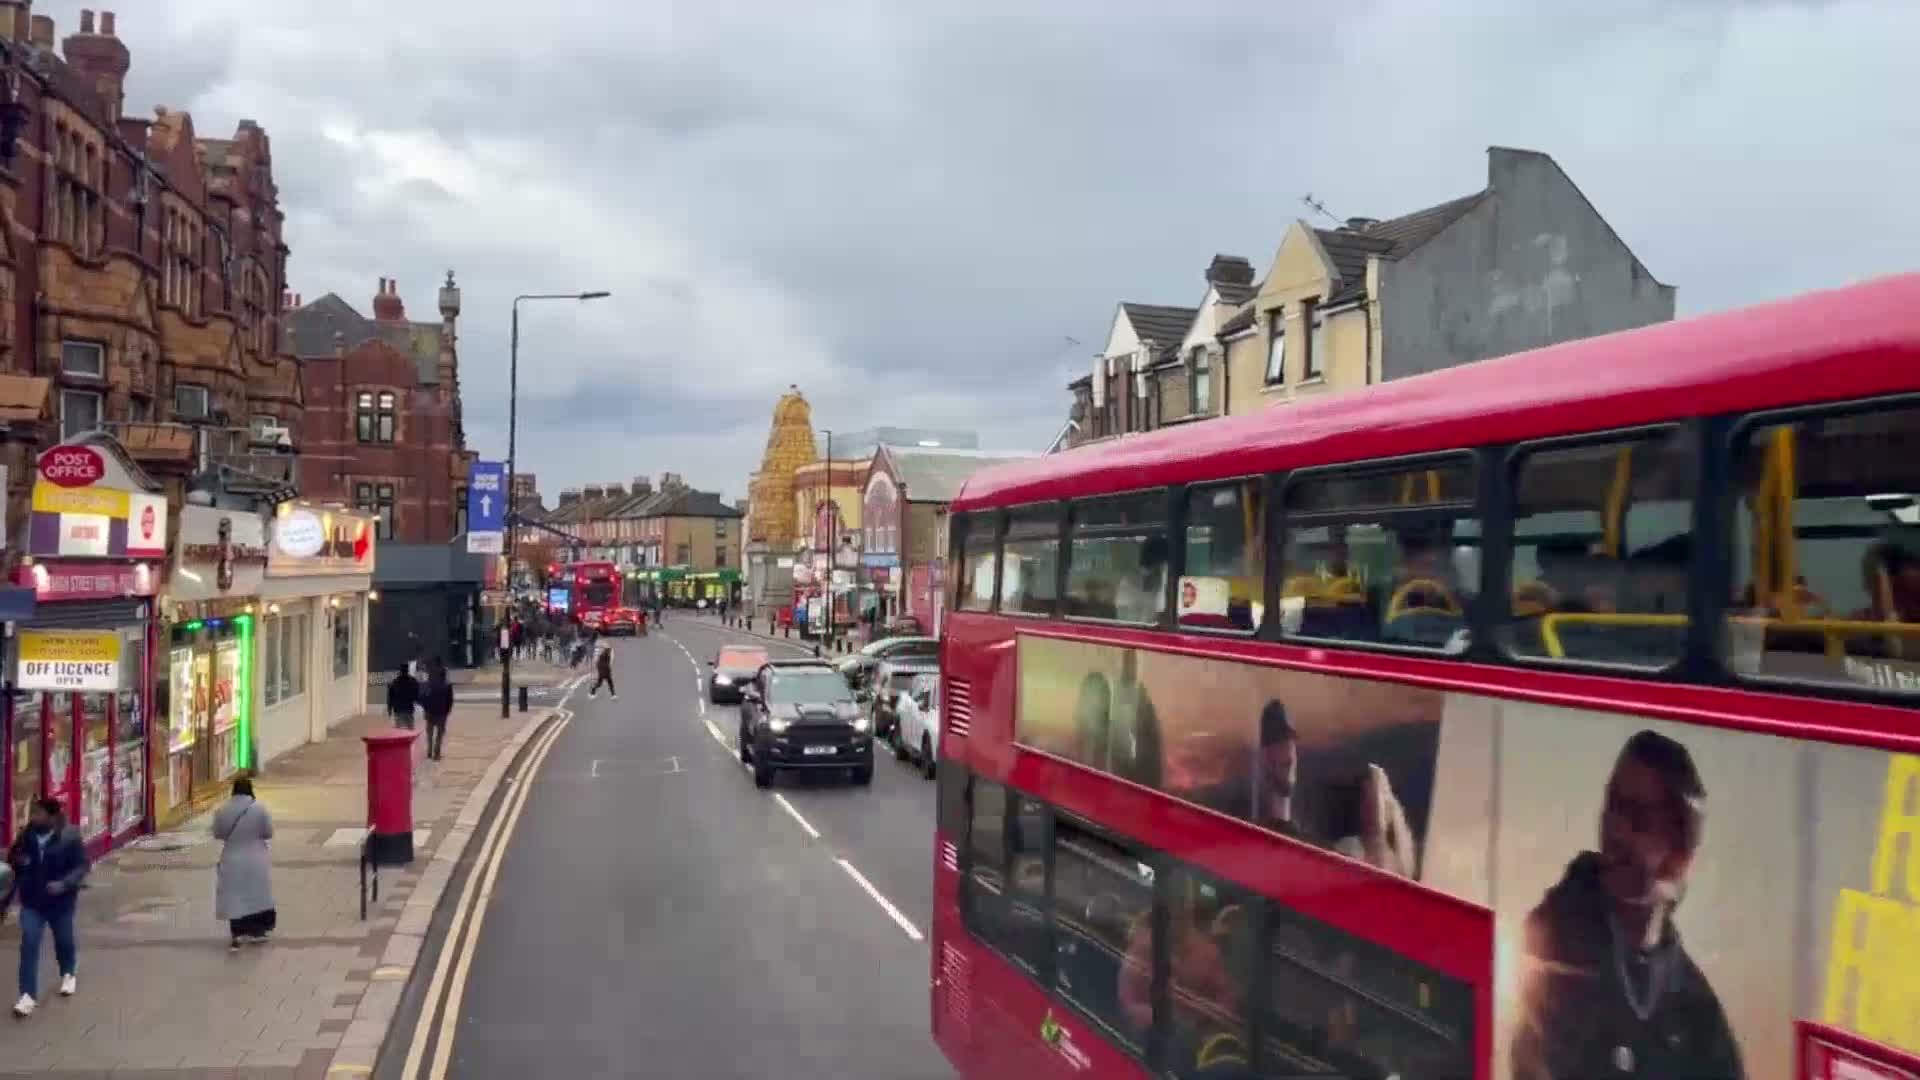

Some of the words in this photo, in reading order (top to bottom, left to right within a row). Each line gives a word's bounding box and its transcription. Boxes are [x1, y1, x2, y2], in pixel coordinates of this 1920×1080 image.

[54, 453, 92, 465] POST
[46, 463, 97, 478] OFFICE
[26, 662, 53, 675] OFF
[55, 662, 112, 675] LICENCE
[56, 676, 84, 686] OPEN
